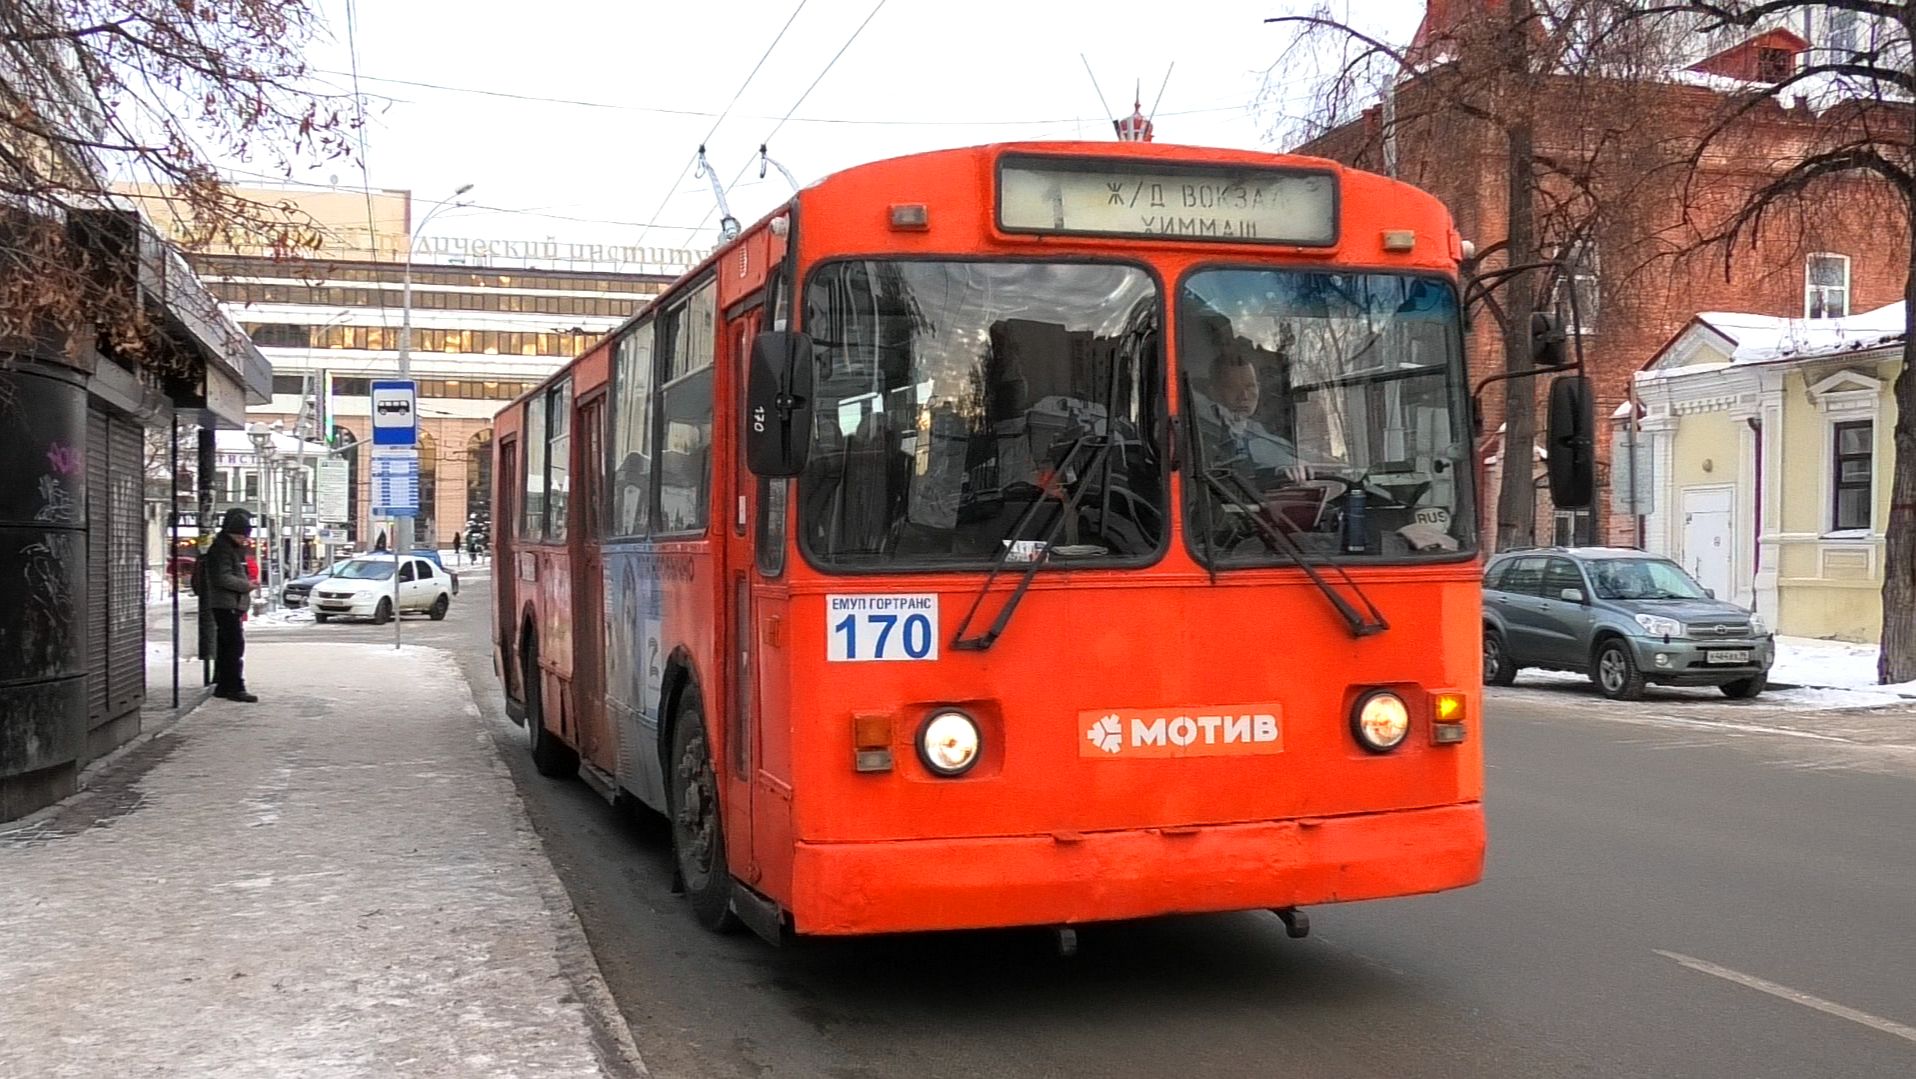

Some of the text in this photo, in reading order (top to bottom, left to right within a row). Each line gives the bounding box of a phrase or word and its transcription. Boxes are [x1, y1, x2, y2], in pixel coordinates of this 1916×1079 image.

[1107, 181, 1166, 209] Ж/Д
[754, 406, 765, 432] 170
[1416, 511, 1446, 525] RUS
[832, 597, 932, 610] ЕМУП ГОРТРАНС
[835, 613, 932, 659] 170
[1130, 714, 1279, 747] МОТИВ
